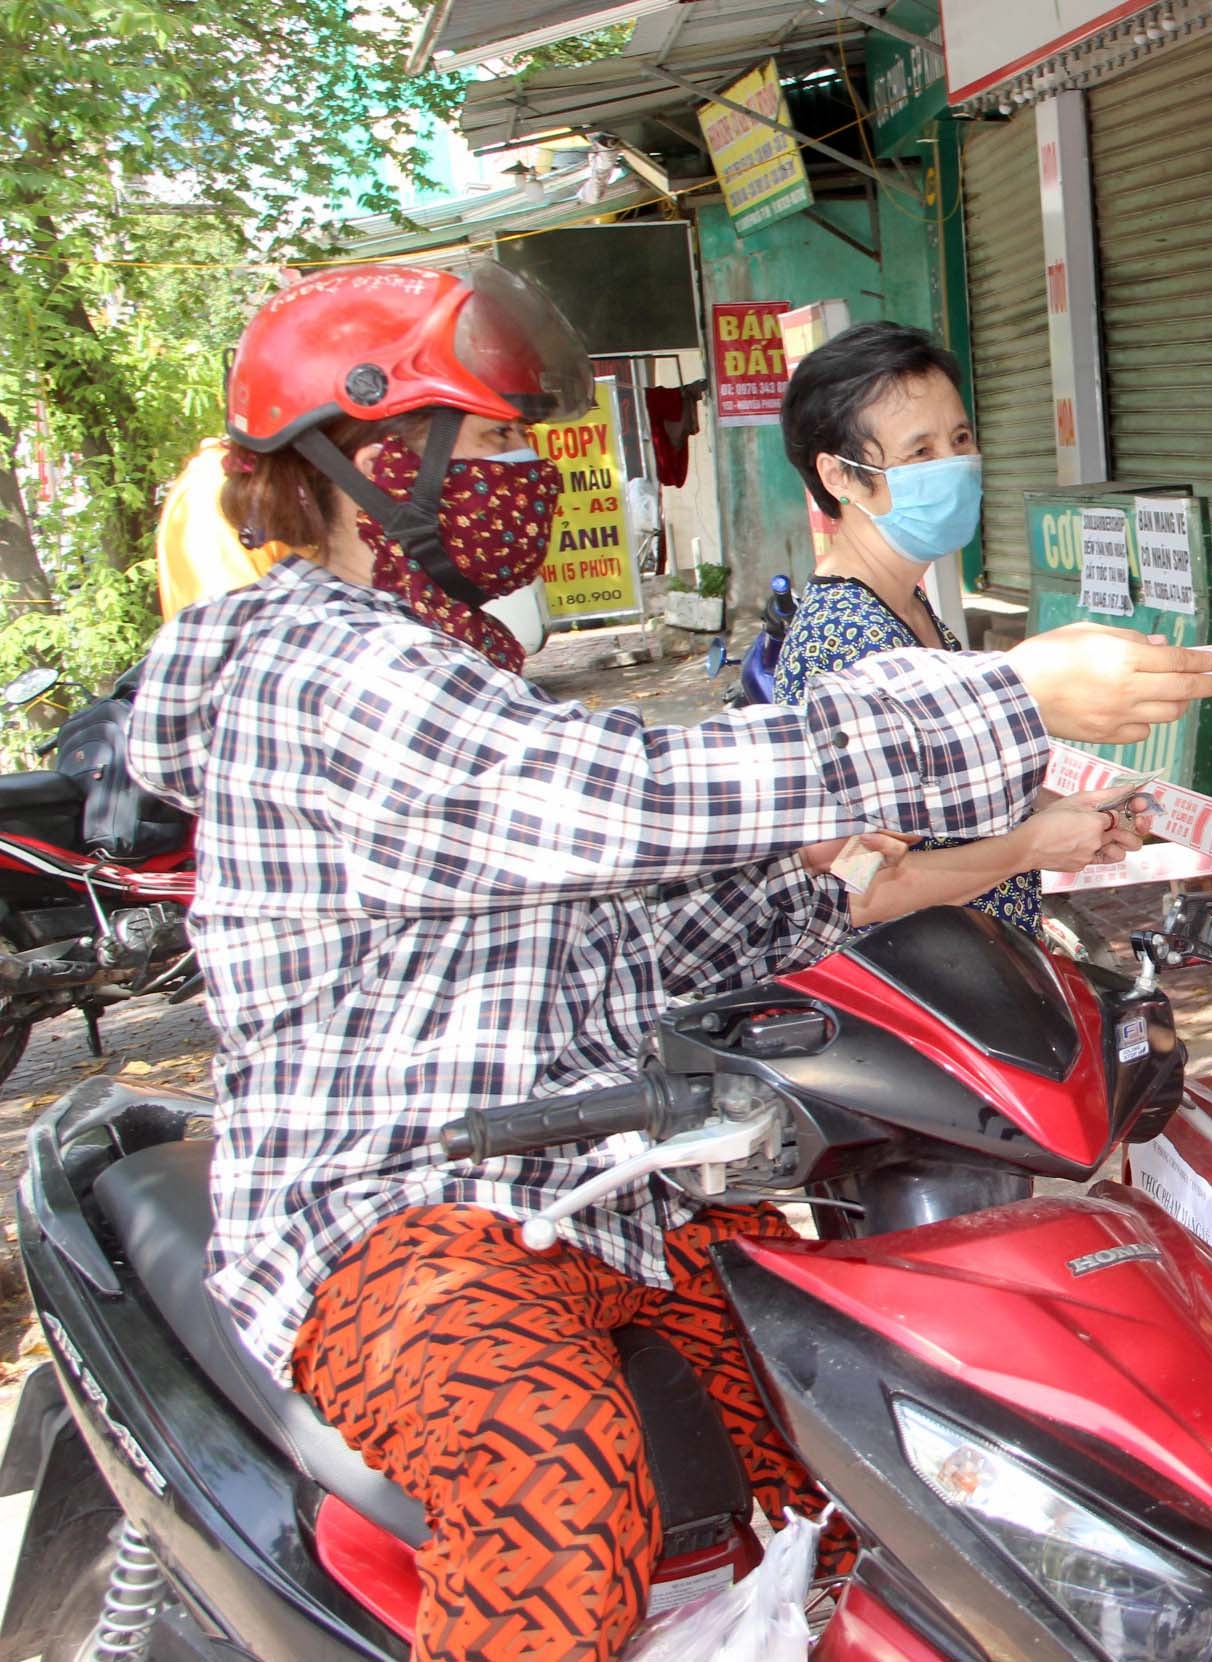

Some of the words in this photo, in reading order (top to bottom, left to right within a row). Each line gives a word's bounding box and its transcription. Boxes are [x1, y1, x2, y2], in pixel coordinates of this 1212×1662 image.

[719, 309, 781, 341] BÁN
[724, 341, 785, 377] ĐẤT
[547, 424, 608, 461] COPY
[571, 465, 612, 493] MÀU
[590, 496, 618, 514] A3
[559, 521, 619, 552] ẢNH
[562, 562, 576, 583] (5
[580, 554, 622, 580] PHÚT)
[1173, 549, 1189, 572] SHIP
[1124, 1022, 1143, 1038] FI
[1067, 1243, 1161, 1276] HOND
